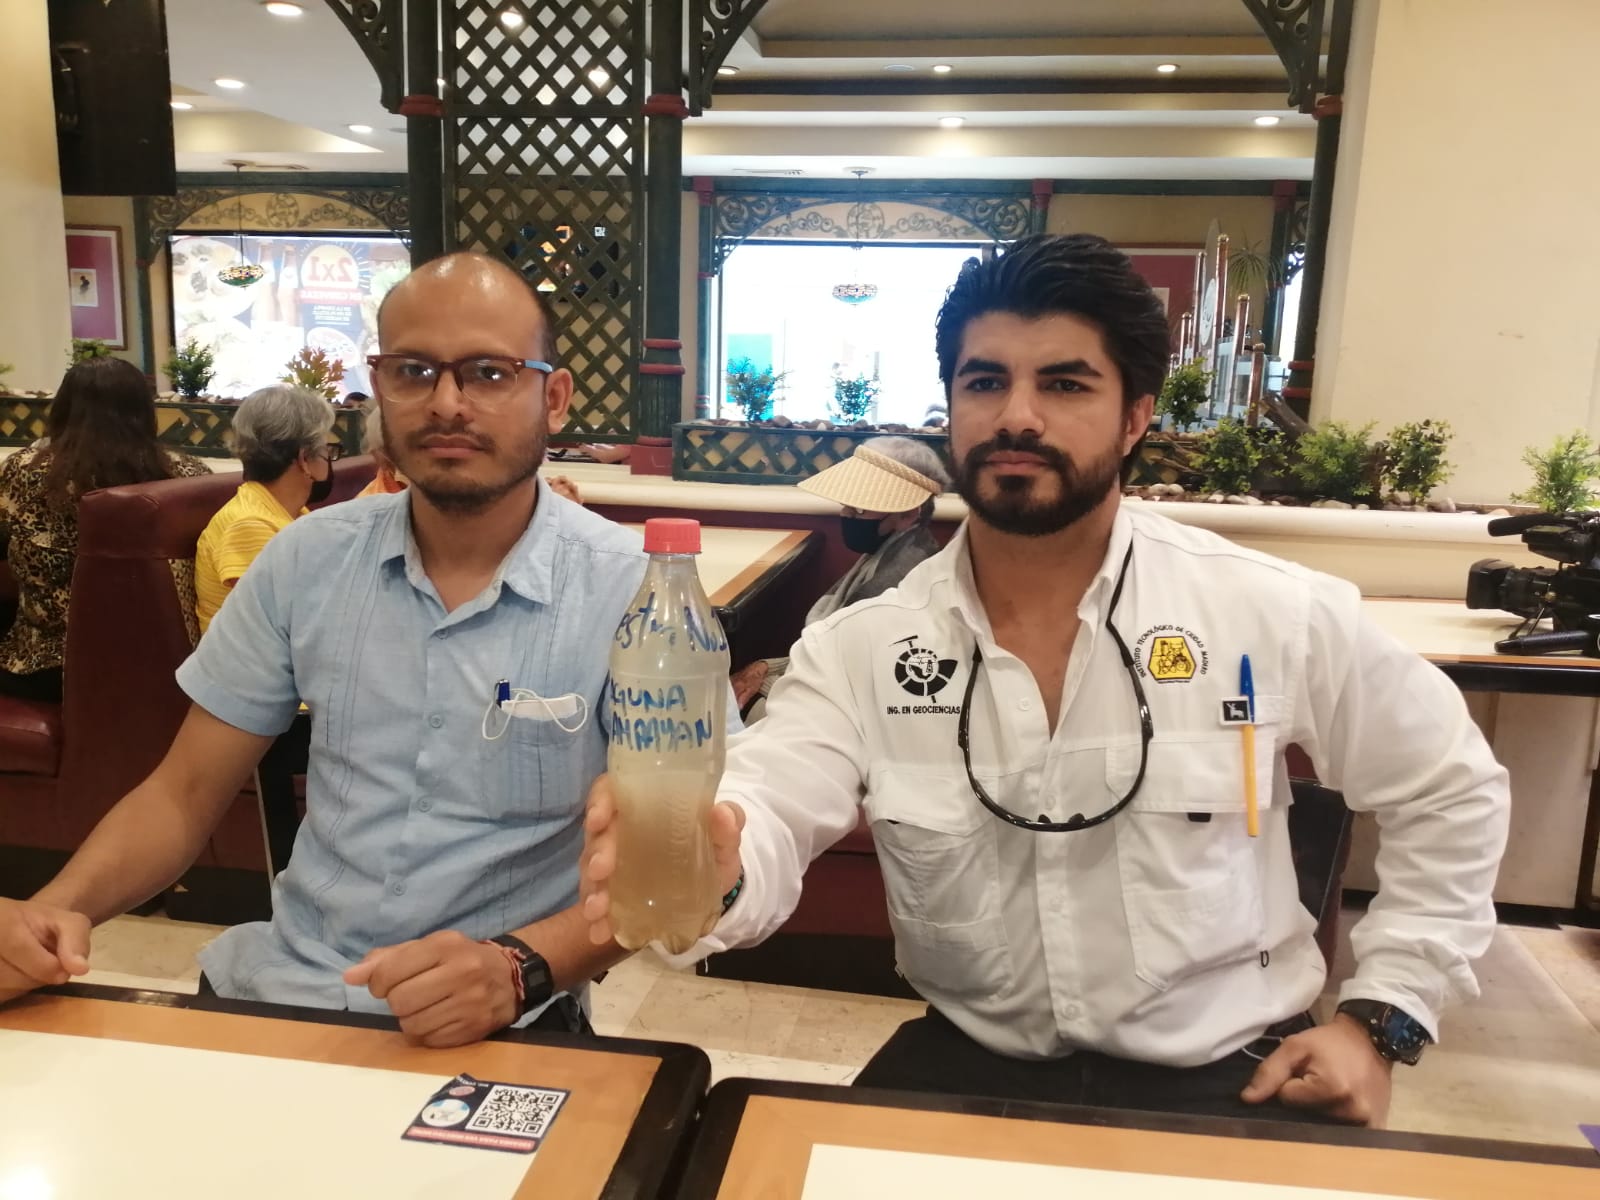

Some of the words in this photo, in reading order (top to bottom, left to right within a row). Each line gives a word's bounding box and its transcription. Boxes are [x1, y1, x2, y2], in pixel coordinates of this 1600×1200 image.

[886, 705, 901, 715] ING.
[902, 705, 911, 715] EN
[912, 705, 961, 715] GEOCIENCIAS
